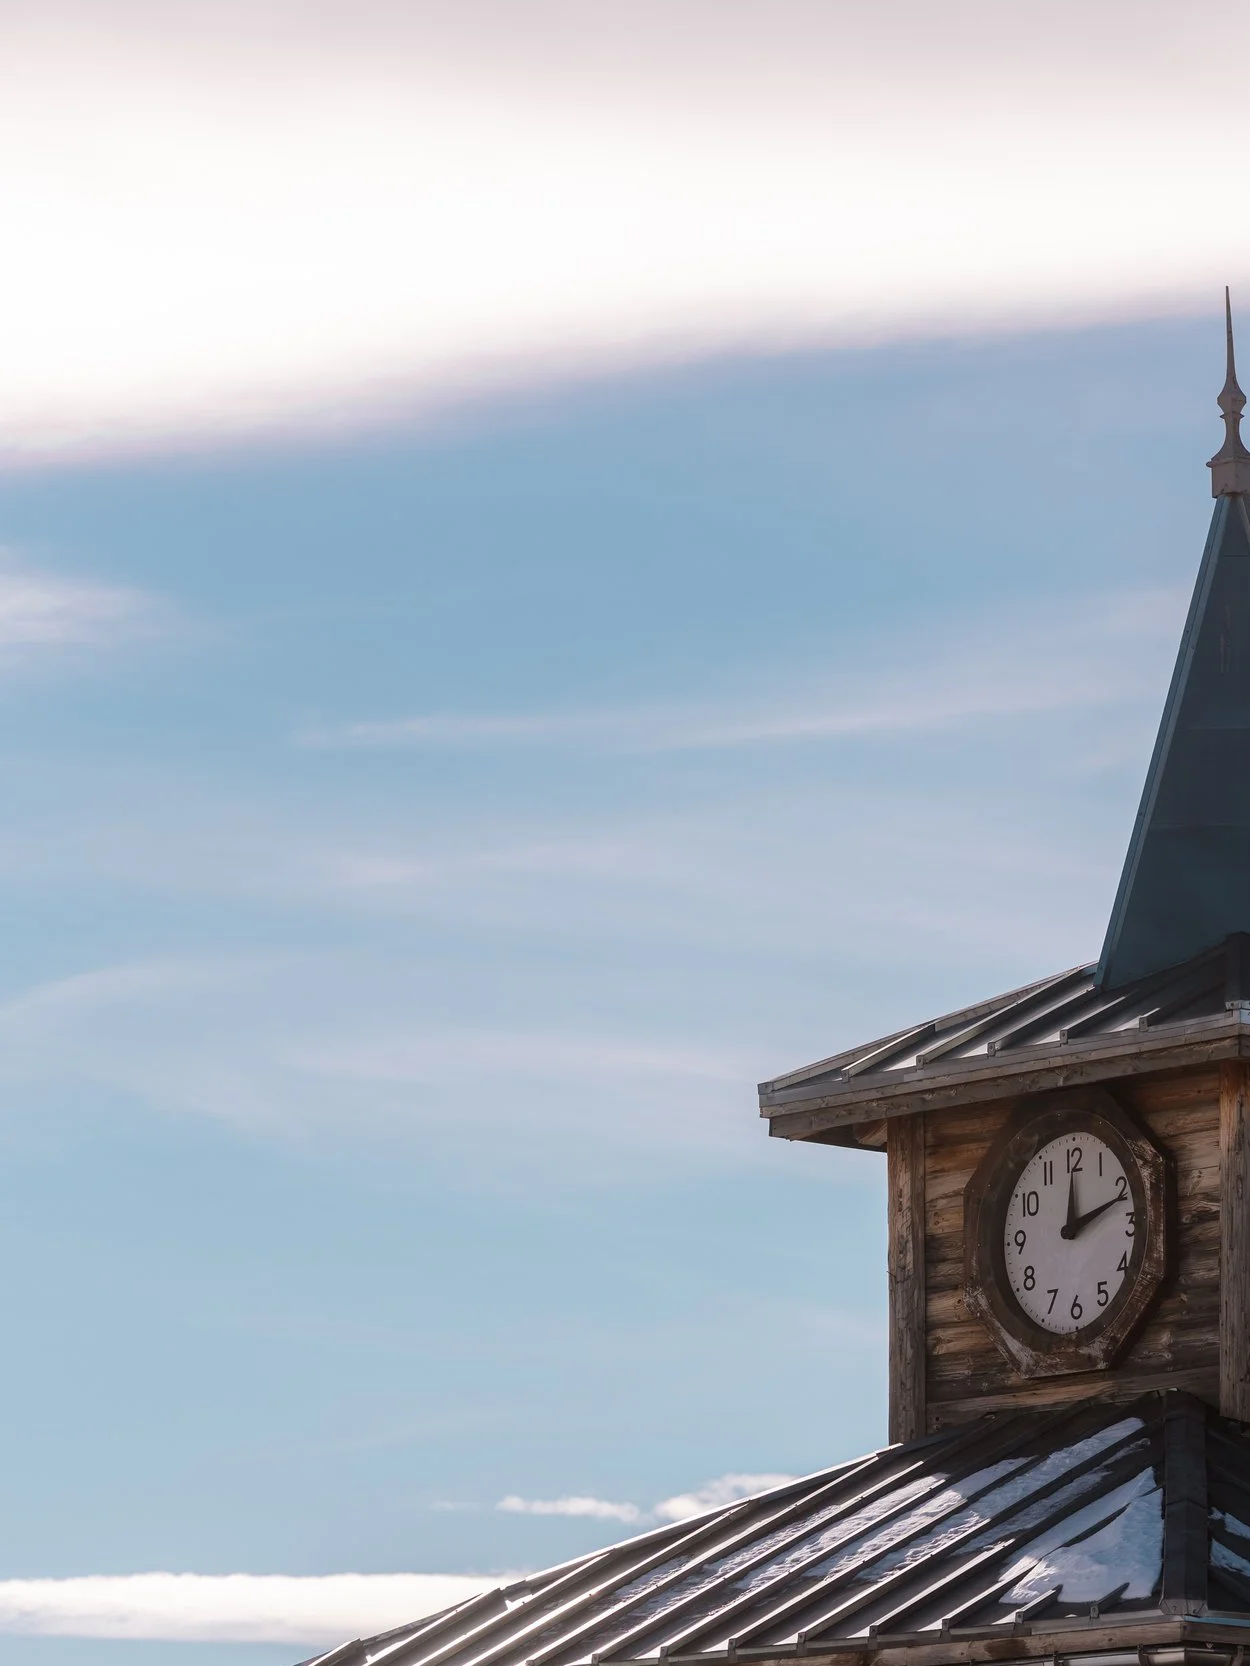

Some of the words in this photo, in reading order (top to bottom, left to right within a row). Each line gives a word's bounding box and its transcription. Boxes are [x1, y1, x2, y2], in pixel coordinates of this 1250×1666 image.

[1043, 1160, 1054, 1186] 11
[1066, 1147, 1083, 1174] 12
[1098, 1151, 1103, 1177] 1
[1114, 1176, 1128, 1201] 2
[1021, 1190, 1040, 1218] 10
[1124, 1212, 1136, 1238] 3
[1013, 1229, 1027, 1255] 9
[1116, 1250, 1129, 1277] 4
[1023, 1265, 1036, 1291] 8
[1046, 1288, 1059, 1315] 7
[1096, 1280, 1109, 1307] 5
[1070, 1294, 1083, 1320] 6
